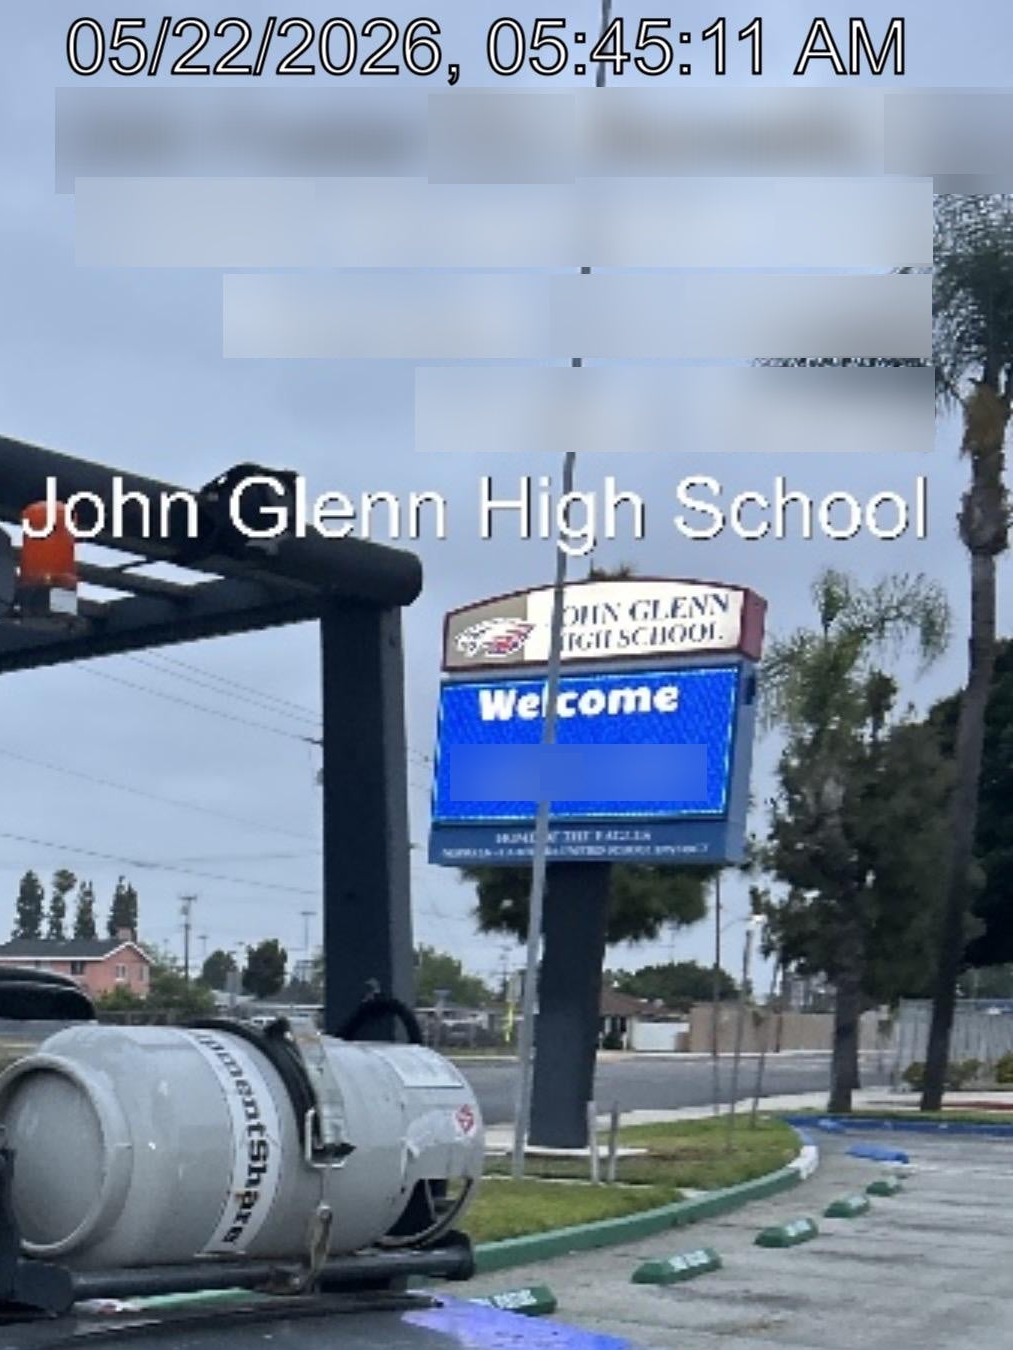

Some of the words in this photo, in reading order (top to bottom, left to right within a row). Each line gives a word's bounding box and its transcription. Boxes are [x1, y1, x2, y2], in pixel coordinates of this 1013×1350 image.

[555, 602, 622, 628] OHN
[628, 593, 730, 622] GLENN
[558, 630, 613, 652] IGH
[616, 620, 724, 648] SCHOOL
[478, 684, 680, 721] Welcome
